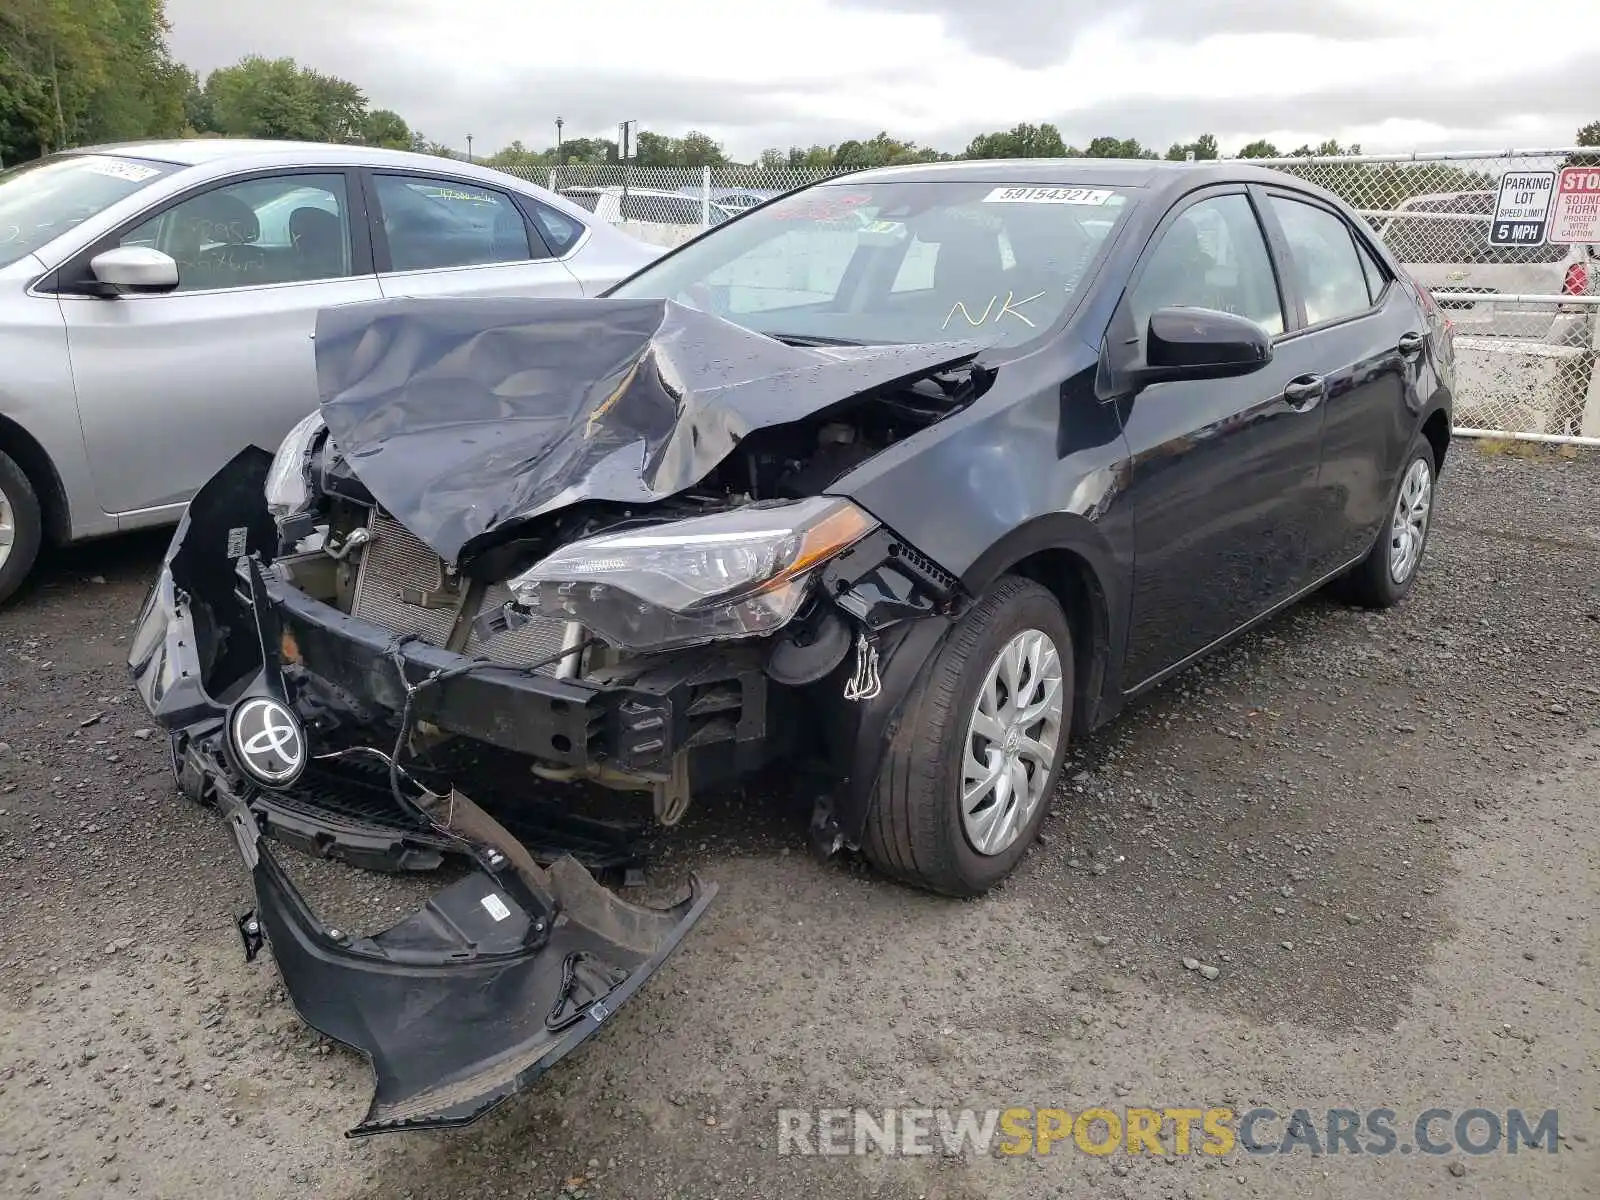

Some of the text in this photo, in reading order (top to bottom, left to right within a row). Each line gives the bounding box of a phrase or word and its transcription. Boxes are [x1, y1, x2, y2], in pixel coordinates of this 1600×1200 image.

[1504, 177, 1550, 190] PARKING
[1564, 174, 1600, 190] STO
[1000, 188, 1093, 200] 59154321
[1514, 191, 1535, 204] LOT
[1499, 208, 1544, 218] SPEED LIMIT
[1567, 205, 1597, 214] HORN
[1498, 224, 1538, 240] 5 MPH
[942, 291, 1046, 329] NK
